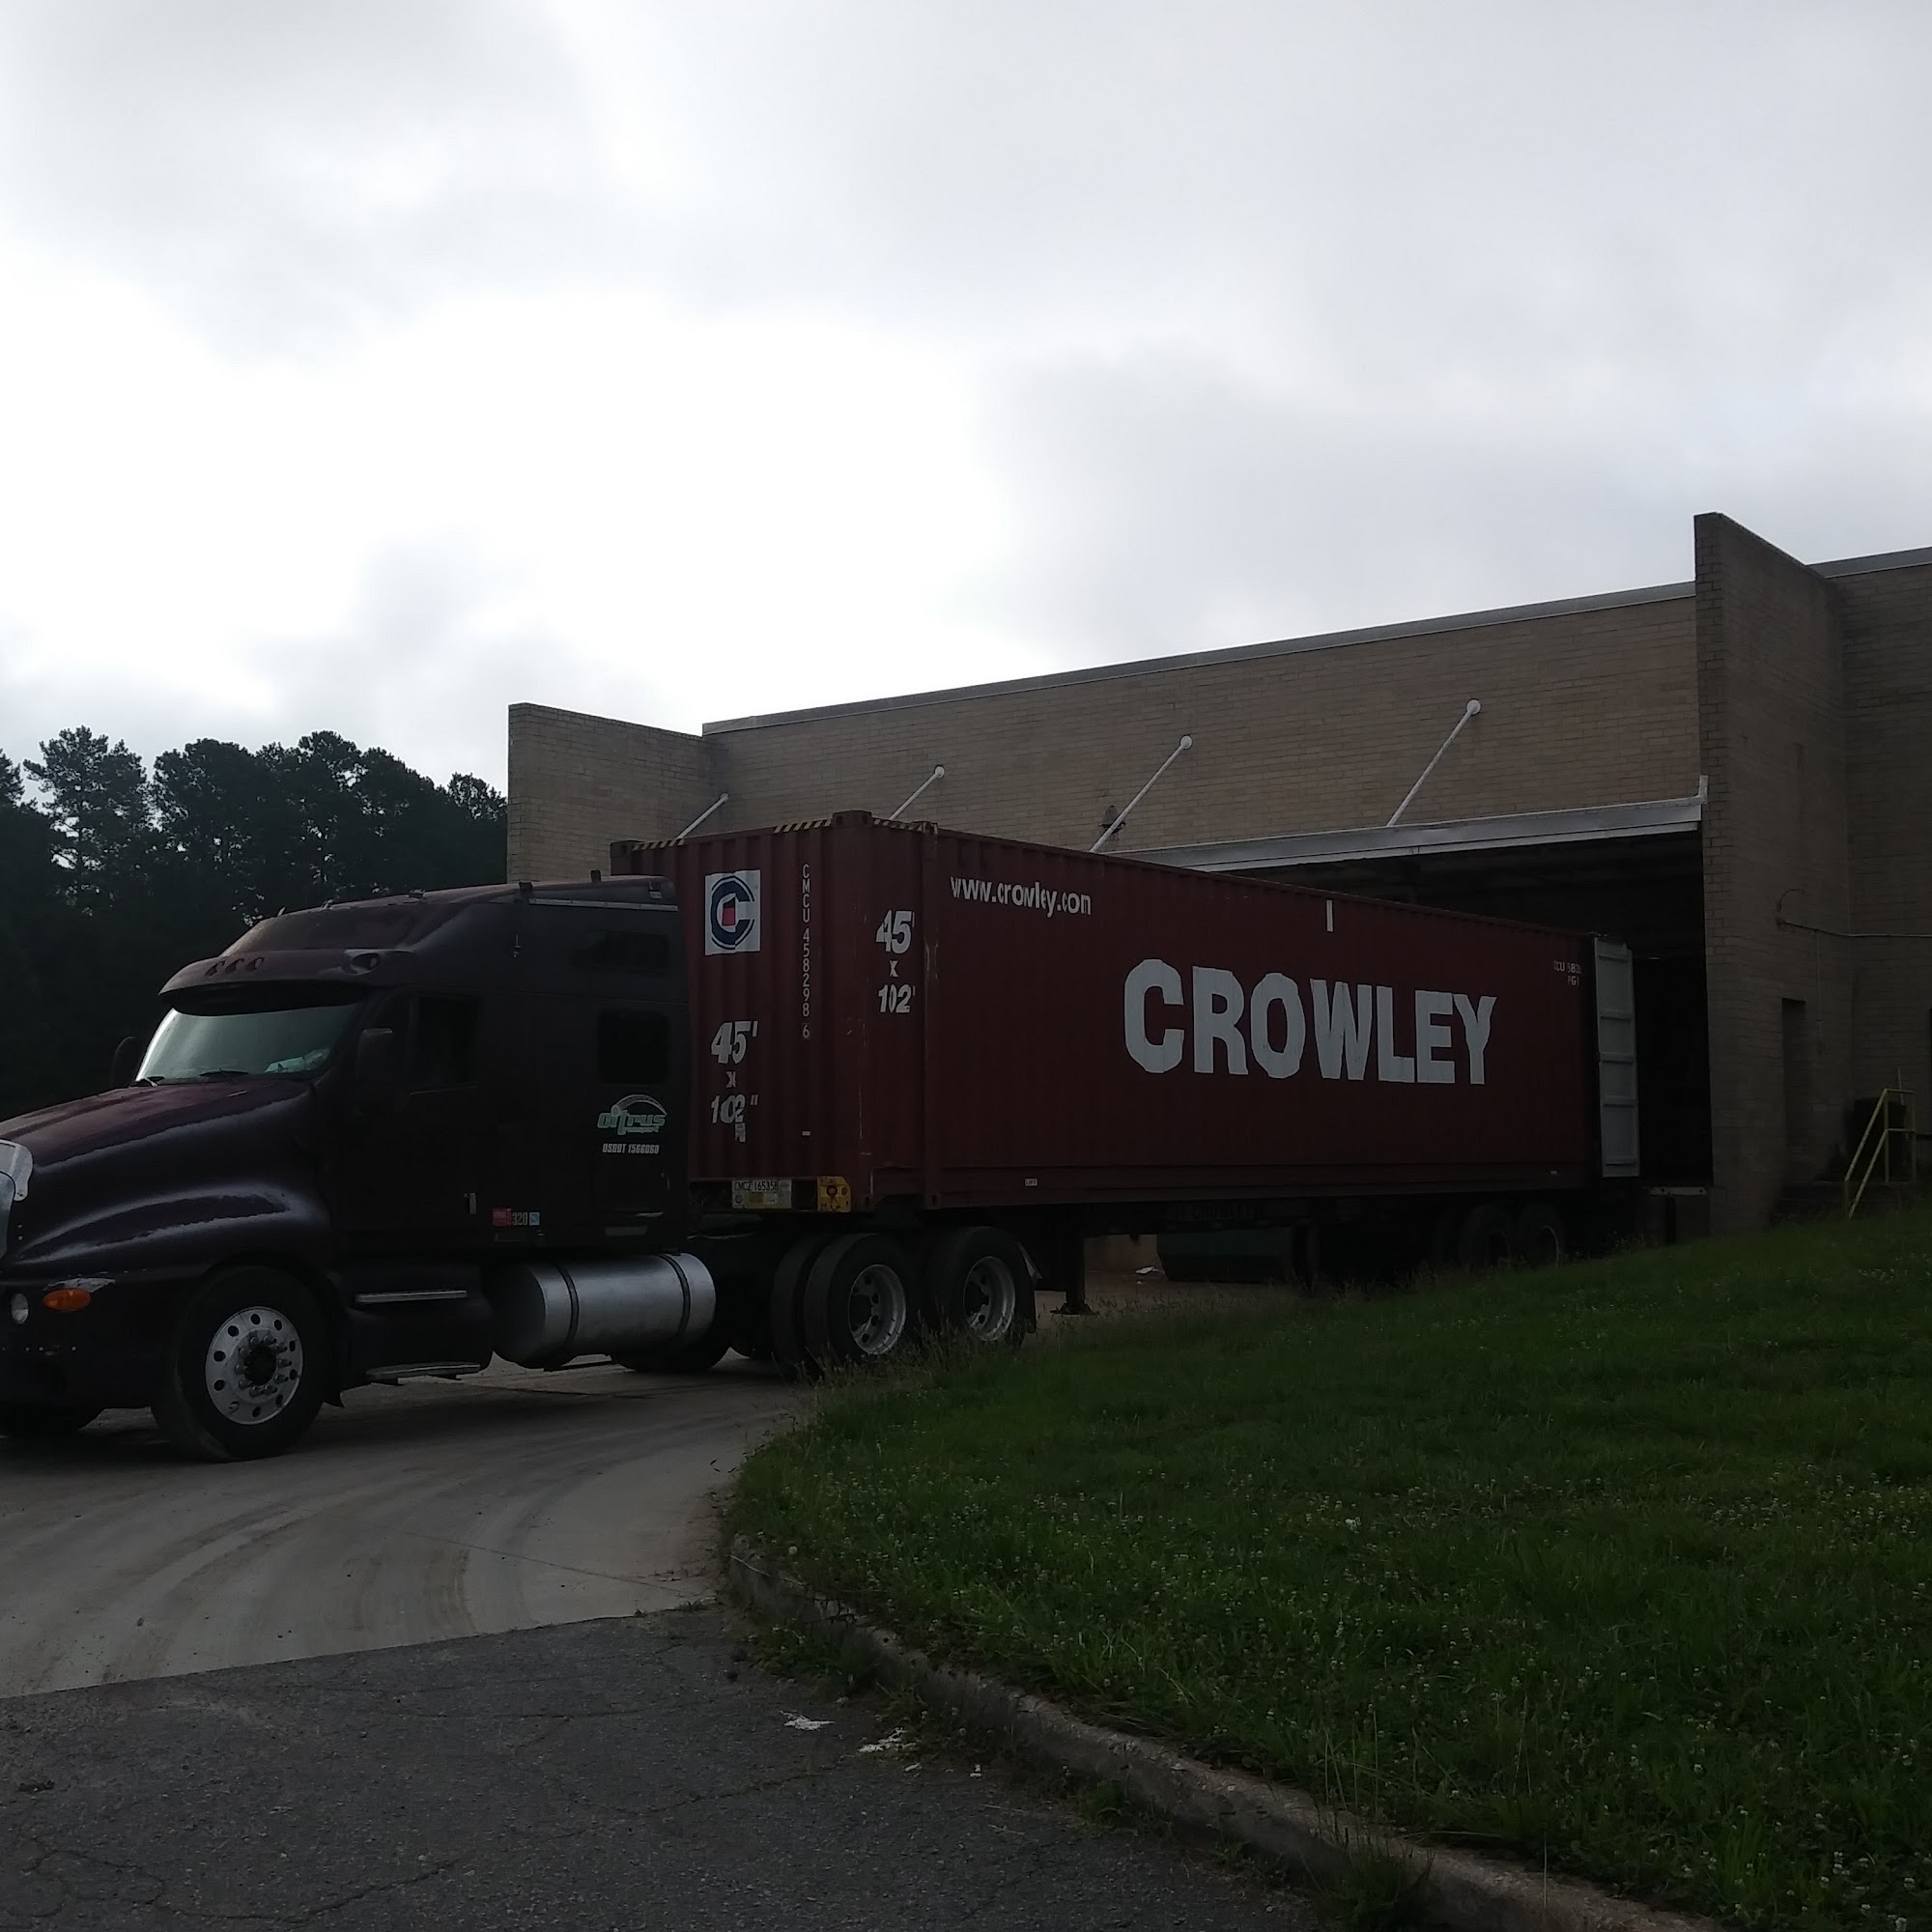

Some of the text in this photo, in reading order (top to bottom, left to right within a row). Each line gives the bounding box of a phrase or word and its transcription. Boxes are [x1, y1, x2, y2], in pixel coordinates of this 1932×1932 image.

[802, 863, 810, 1039] CMCU 458298 6
[1123, 957, 1498, 1086] CROWLEY
[512, 1211, 528, 1226] 320
